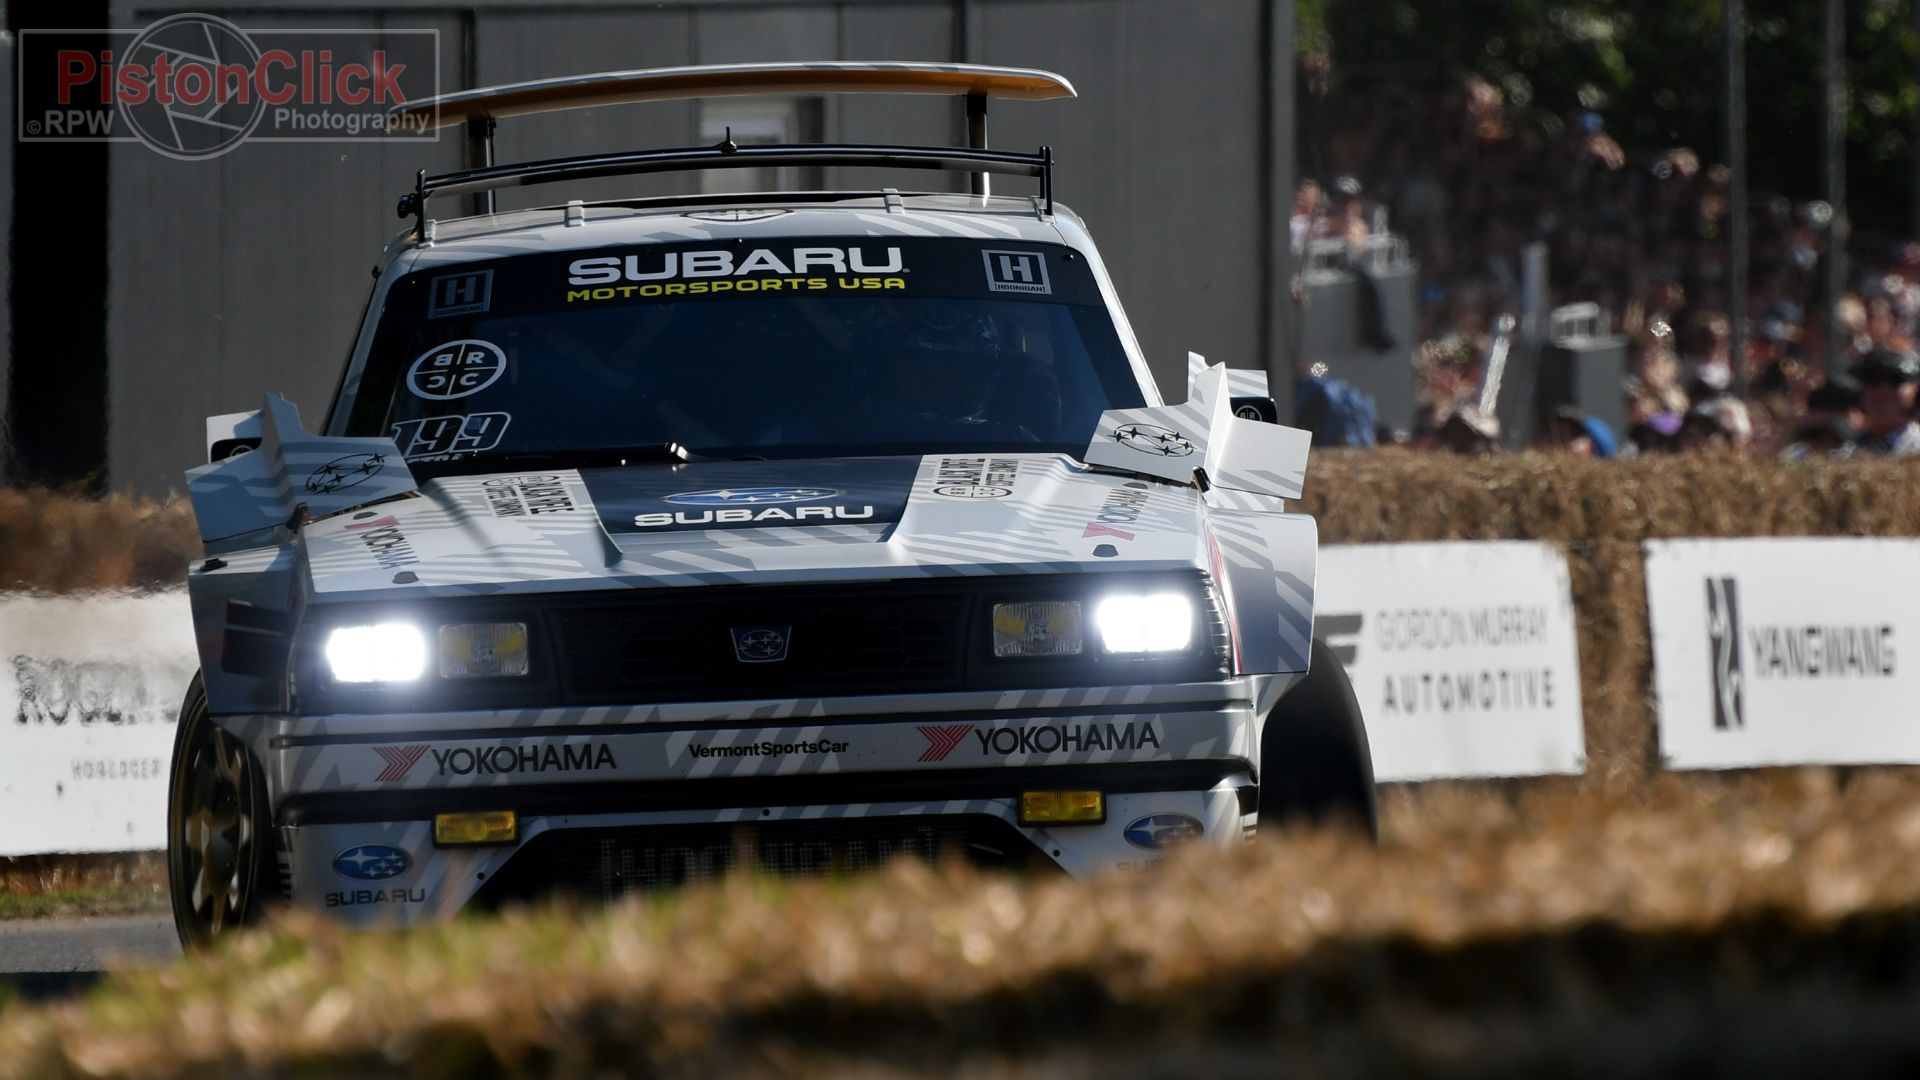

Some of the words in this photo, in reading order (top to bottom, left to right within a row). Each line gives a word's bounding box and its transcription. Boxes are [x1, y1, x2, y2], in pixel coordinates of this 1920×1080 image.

[568, 247, 903, 286] SUBARU
[567, 278, 828, 302] MOTORSPORTS
[838, 278, 906, 290] USA
[391, 411, 512, 459] 199
[634, 505, 873, 527] SUBARU
[1748, 625, 1896, 679] YANGWANG
[1381, 670, 1555, 716] AUTOMOTIVE
[688, 739, 849, 759] VermontSportsCar
[974, 721, 1161, 756] YOKOHAMA
[431, 743, 617, 776] YOKOHAMA
[325, 888, 426, 908] SUBARU
